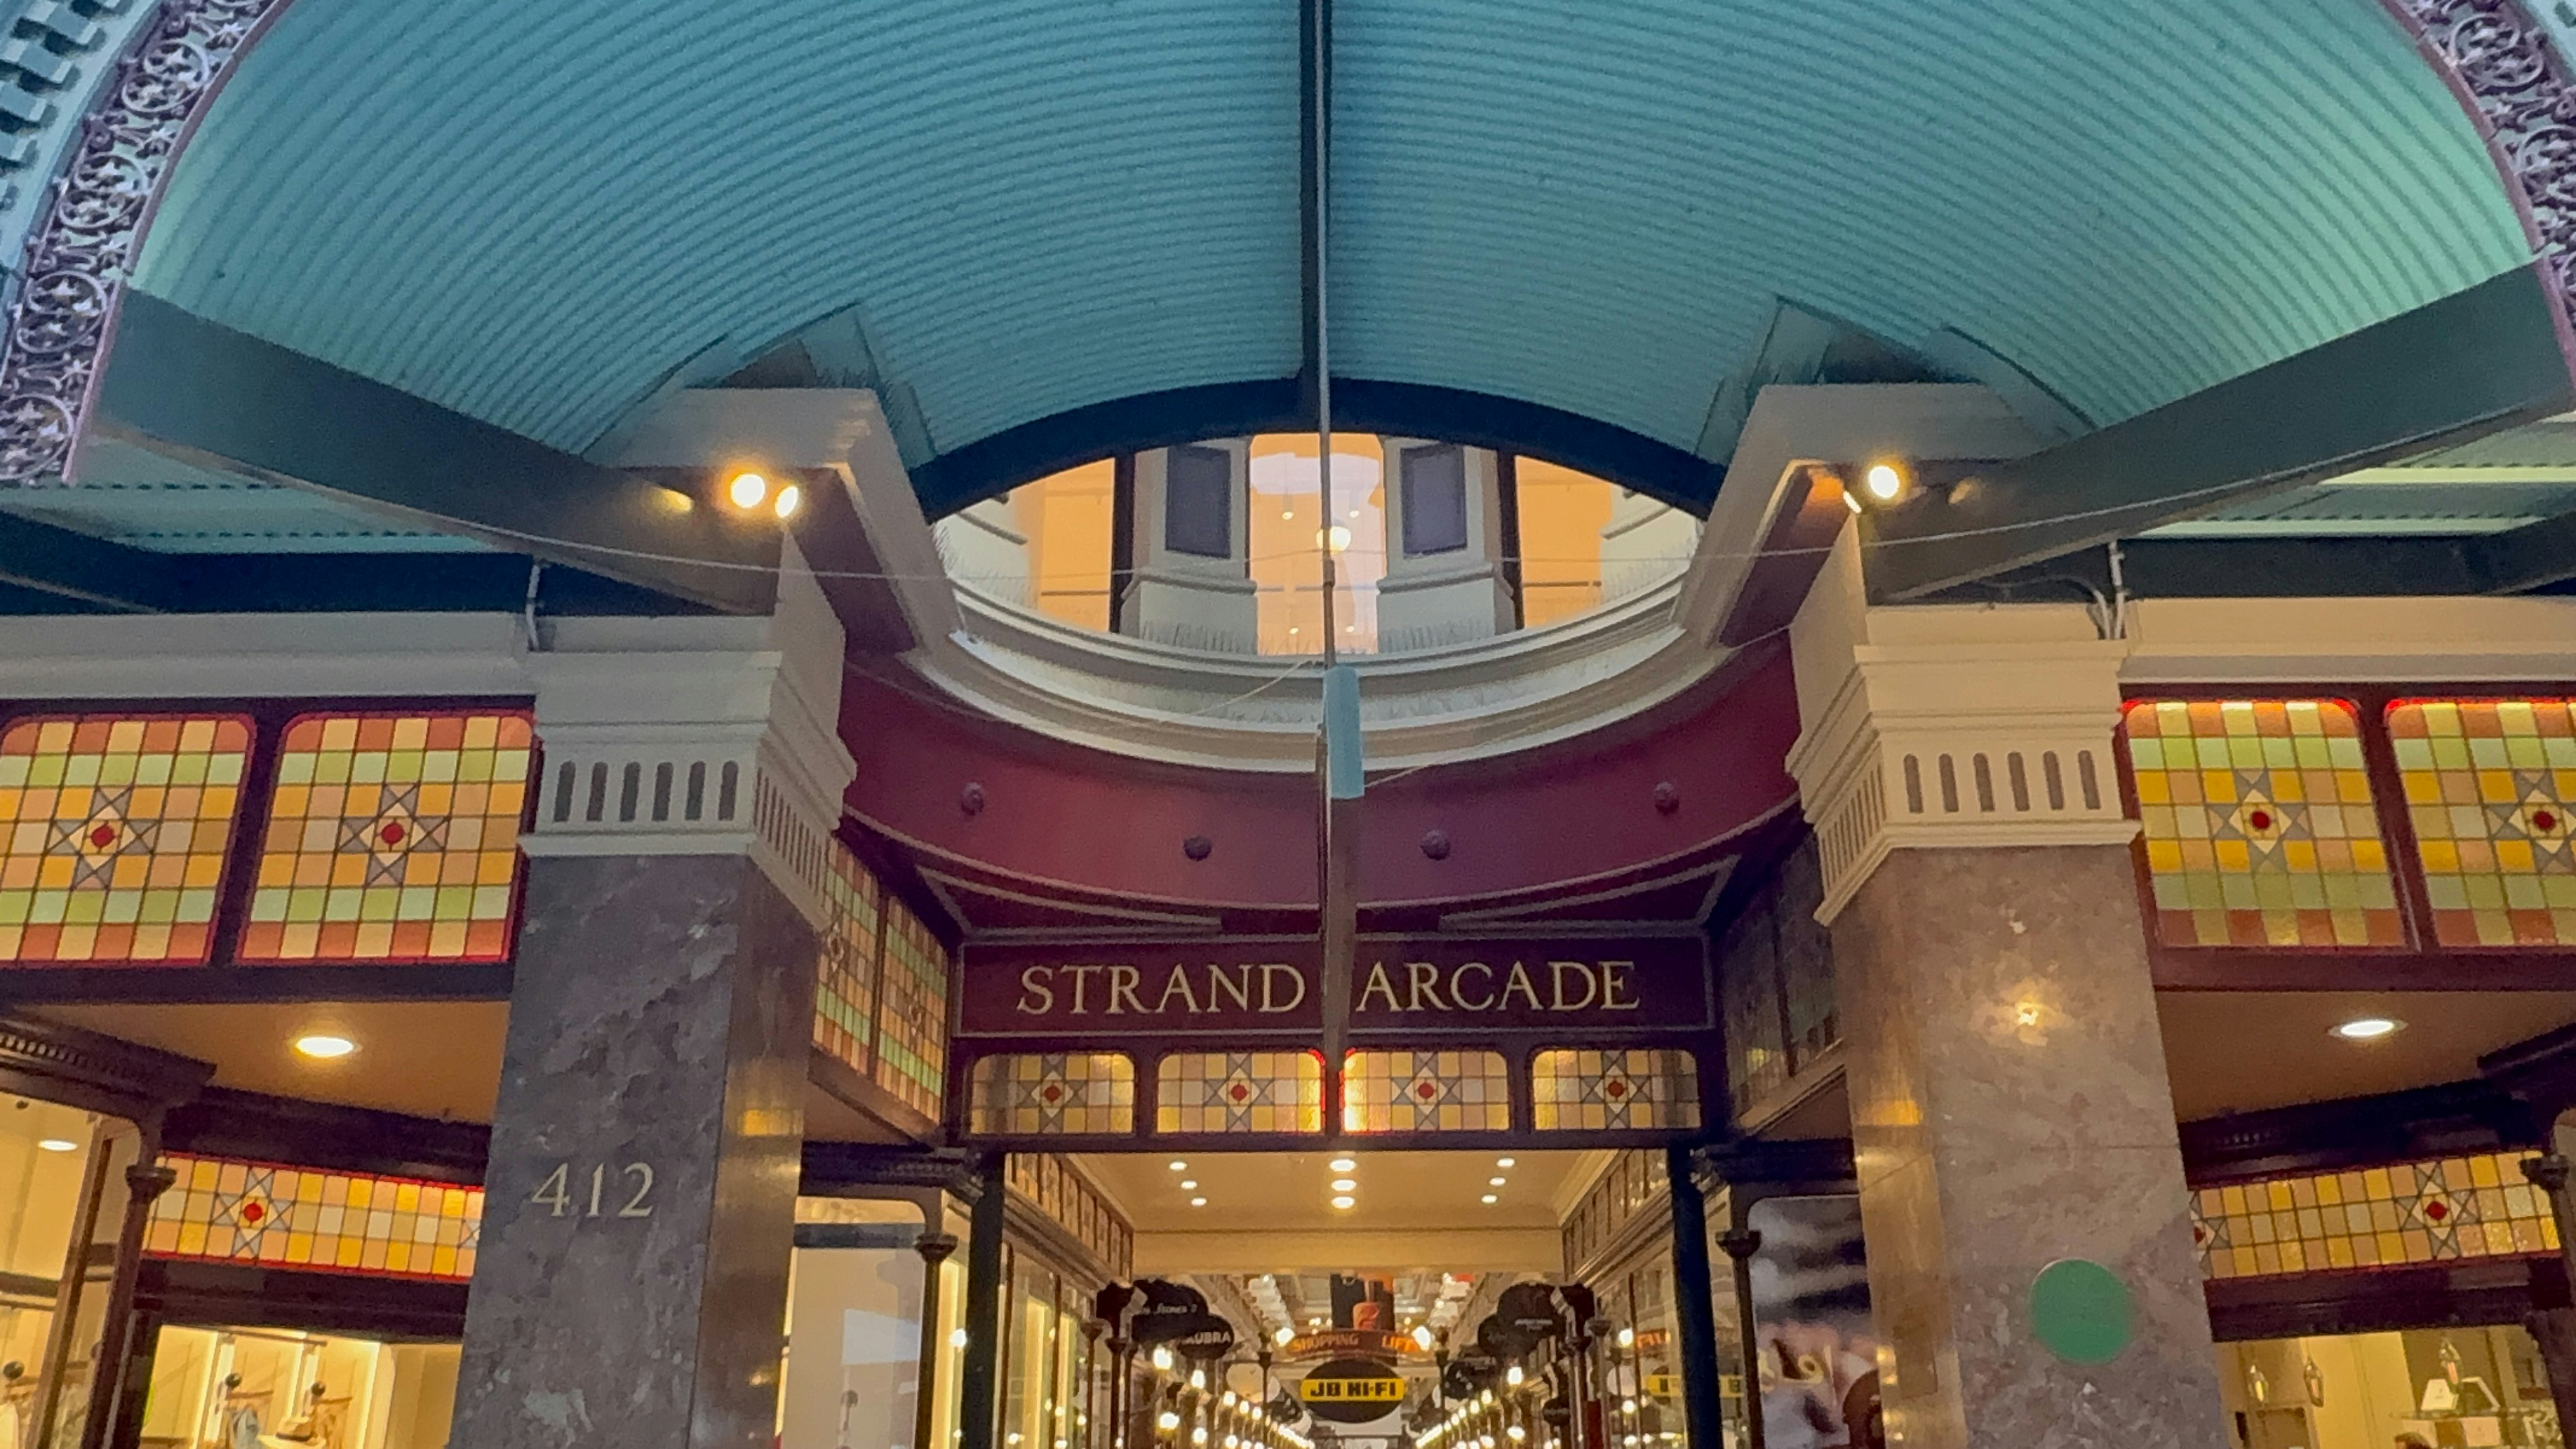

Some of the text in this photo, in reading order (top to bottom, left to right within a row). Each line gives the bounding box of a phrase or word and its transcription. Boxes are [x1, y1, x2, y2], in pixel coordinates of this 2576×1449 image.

[1017, 960, 1640, 1015] STRAND ARCADE
[531, 1161, 653, 1218] 412
[1292, 1333, 1359, 1352] SHOPPING
[1310, 1382, 1341, 1396] JB
